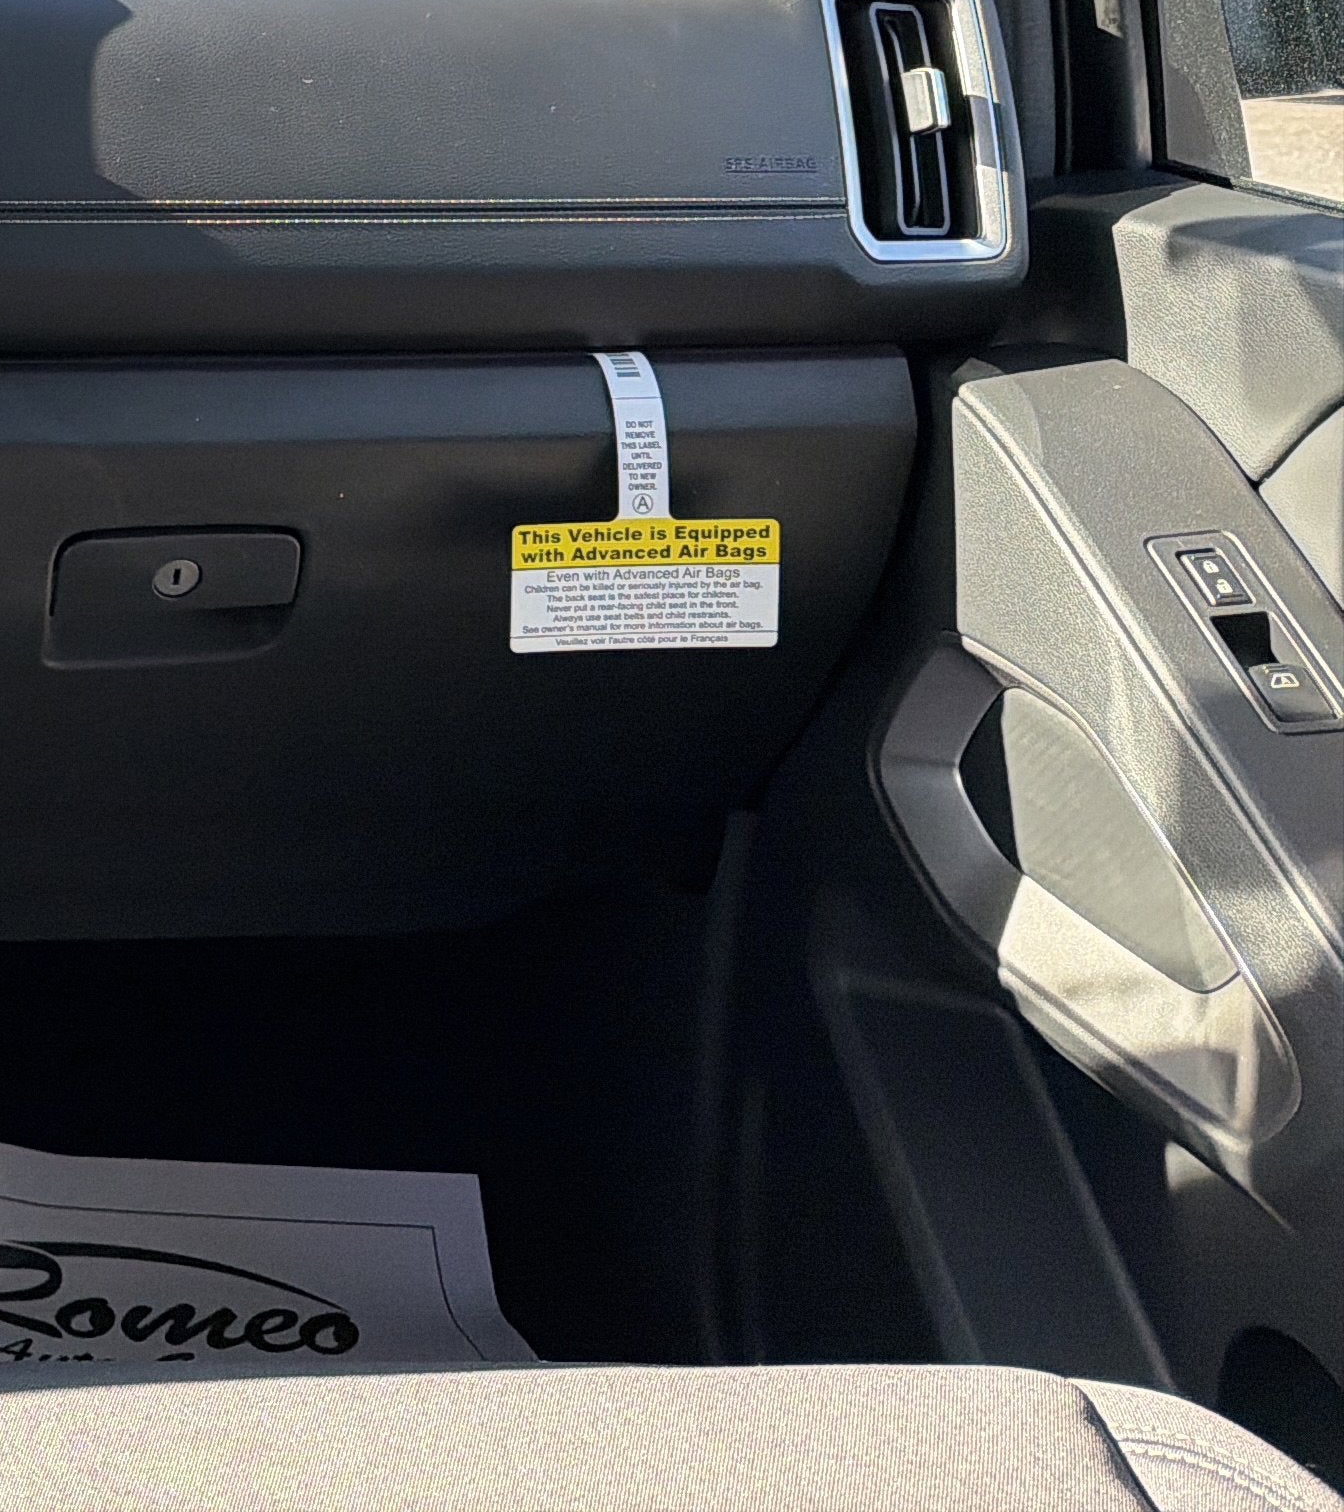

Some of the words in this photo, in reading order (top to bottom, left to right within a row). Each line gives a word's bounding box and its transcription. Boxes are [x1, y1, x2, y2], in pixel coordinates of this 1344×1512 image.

[625, 421, 637, 429] DO
[638, 420, 653, 428] NOT
[625, 431, 656, 439] REMOVE
[621, 441, 637, 450] THIS
[638, 441, 662, 449] LABEL
[631, 452, 653, 460] UNTIL
[622, 461, 662, 470] DELIVERED
[628, 473, 639, 481] TO
[640, 472, 656, 480] NEW
[636, 495, 649, 510] A
[518, 529, 561, 545] This
[568, 527, 643, 544] Vehicle
[650, 526, 667, 540] is
[674, 524, 771, 544] Equipped
[521, 548, 565, 564] with
[571, 545, 672, 563] Advanced
[678, 544, 708, 559] Air
[715, 544, 767, 561] Bags
[547, 570, 580, 583] Even
[583, 569, 610, 581] with
[613, 567, 679, 581] Advanced
[682, 567, 702, 579] Air
[705, 566, 741, 581] Bags
[524, 584, 559, 594] Children
[592, 583, 614, 591] killed
[628, 581, 666, 591] seriously
[668, 581, 698, 591] injured
[700, 581, 711, 590] by
[713, 581, 728, 589] the
[729, 581, 741, 589] air
[522, 626, 539, 634] See
[576, 623, 608, 632] manual
[648, 621, 696, 629] information
[698, 621, 723, 629] about
